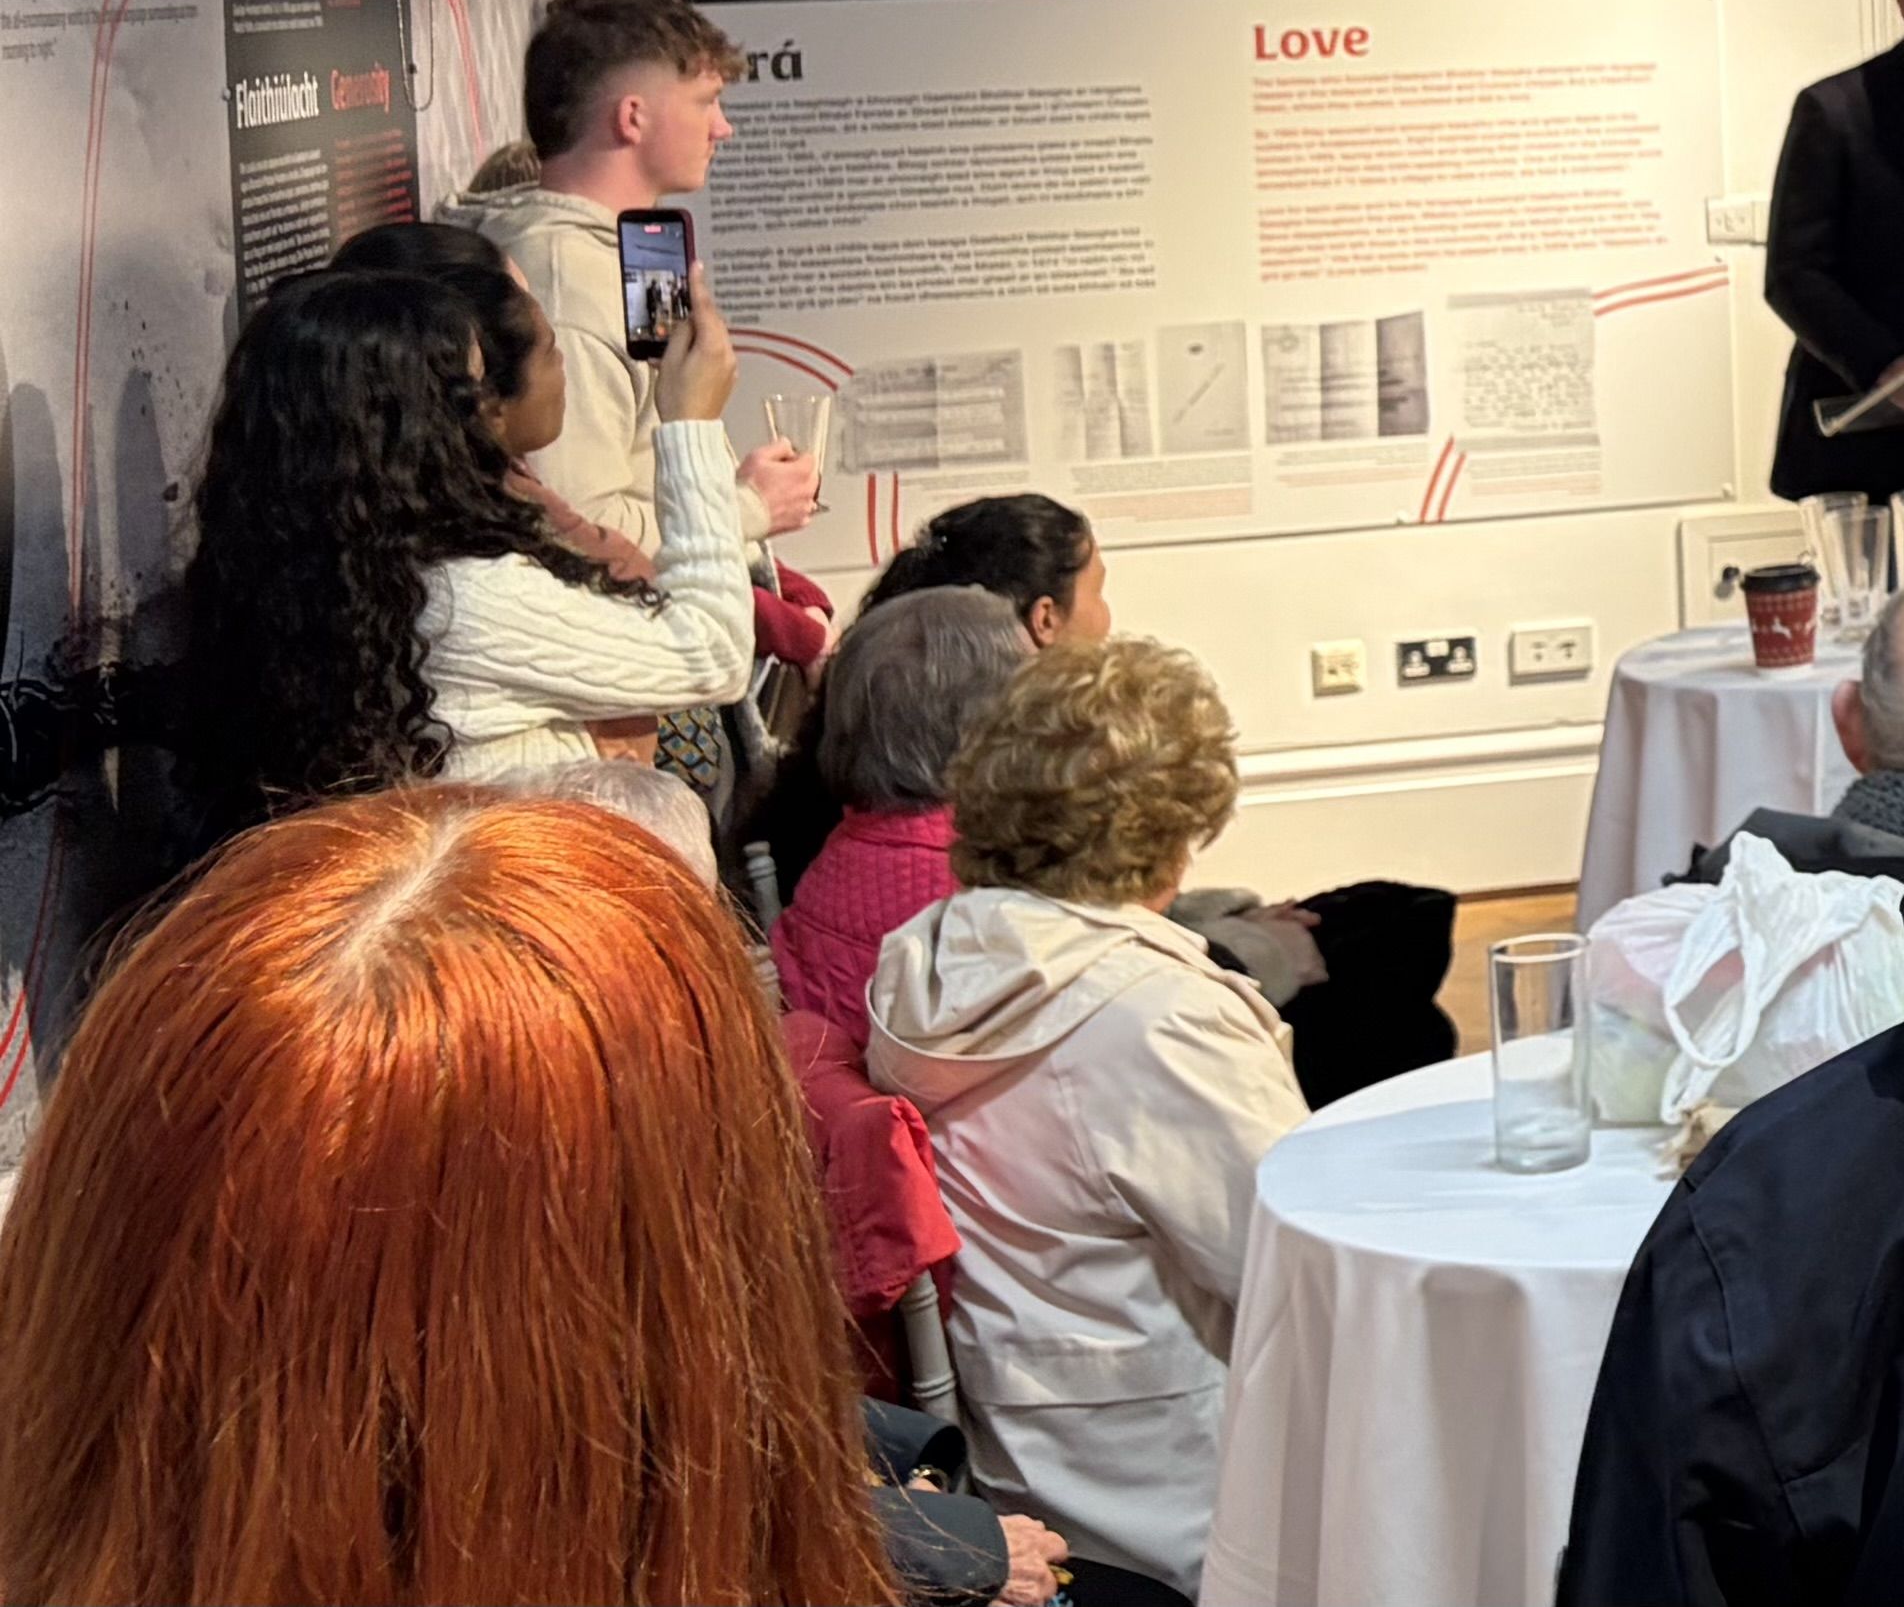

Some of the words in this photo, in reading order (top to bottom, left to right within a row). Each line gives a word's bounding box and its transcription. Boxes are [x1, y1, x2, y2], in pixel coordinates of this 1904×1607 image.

[745, 39, 804, 81] rá
[1252, 23, 1371, 61] Love
[235, 71, 320, 130] Flaithiúlacht
